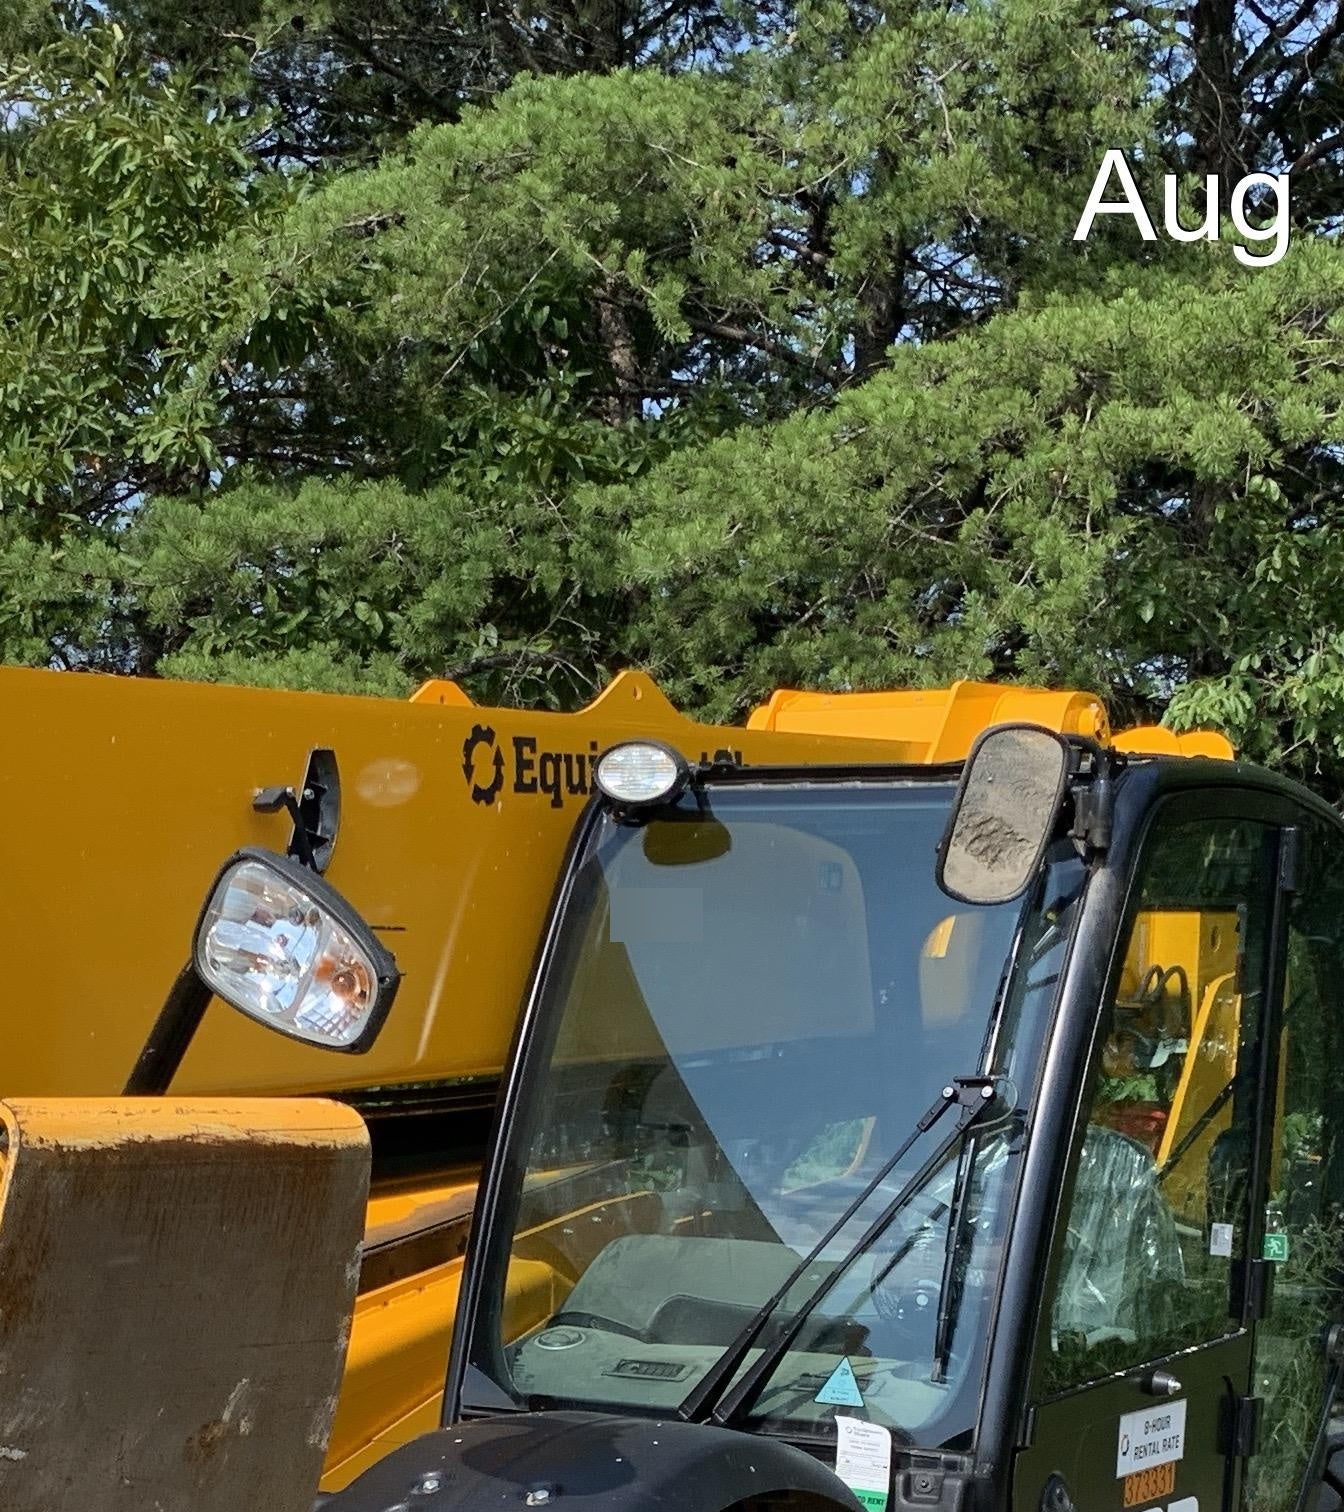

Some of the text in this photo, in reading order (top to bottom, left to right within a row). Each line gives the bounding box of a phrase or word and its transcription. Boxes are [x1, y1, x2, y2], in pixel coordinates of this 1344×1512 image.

[1144, 1415, 1171, 1435] 8-HOUR
[1133, 1434, 1180, 1461] RENTAL RATE
[867, 1496, 884, 1506] RENT
